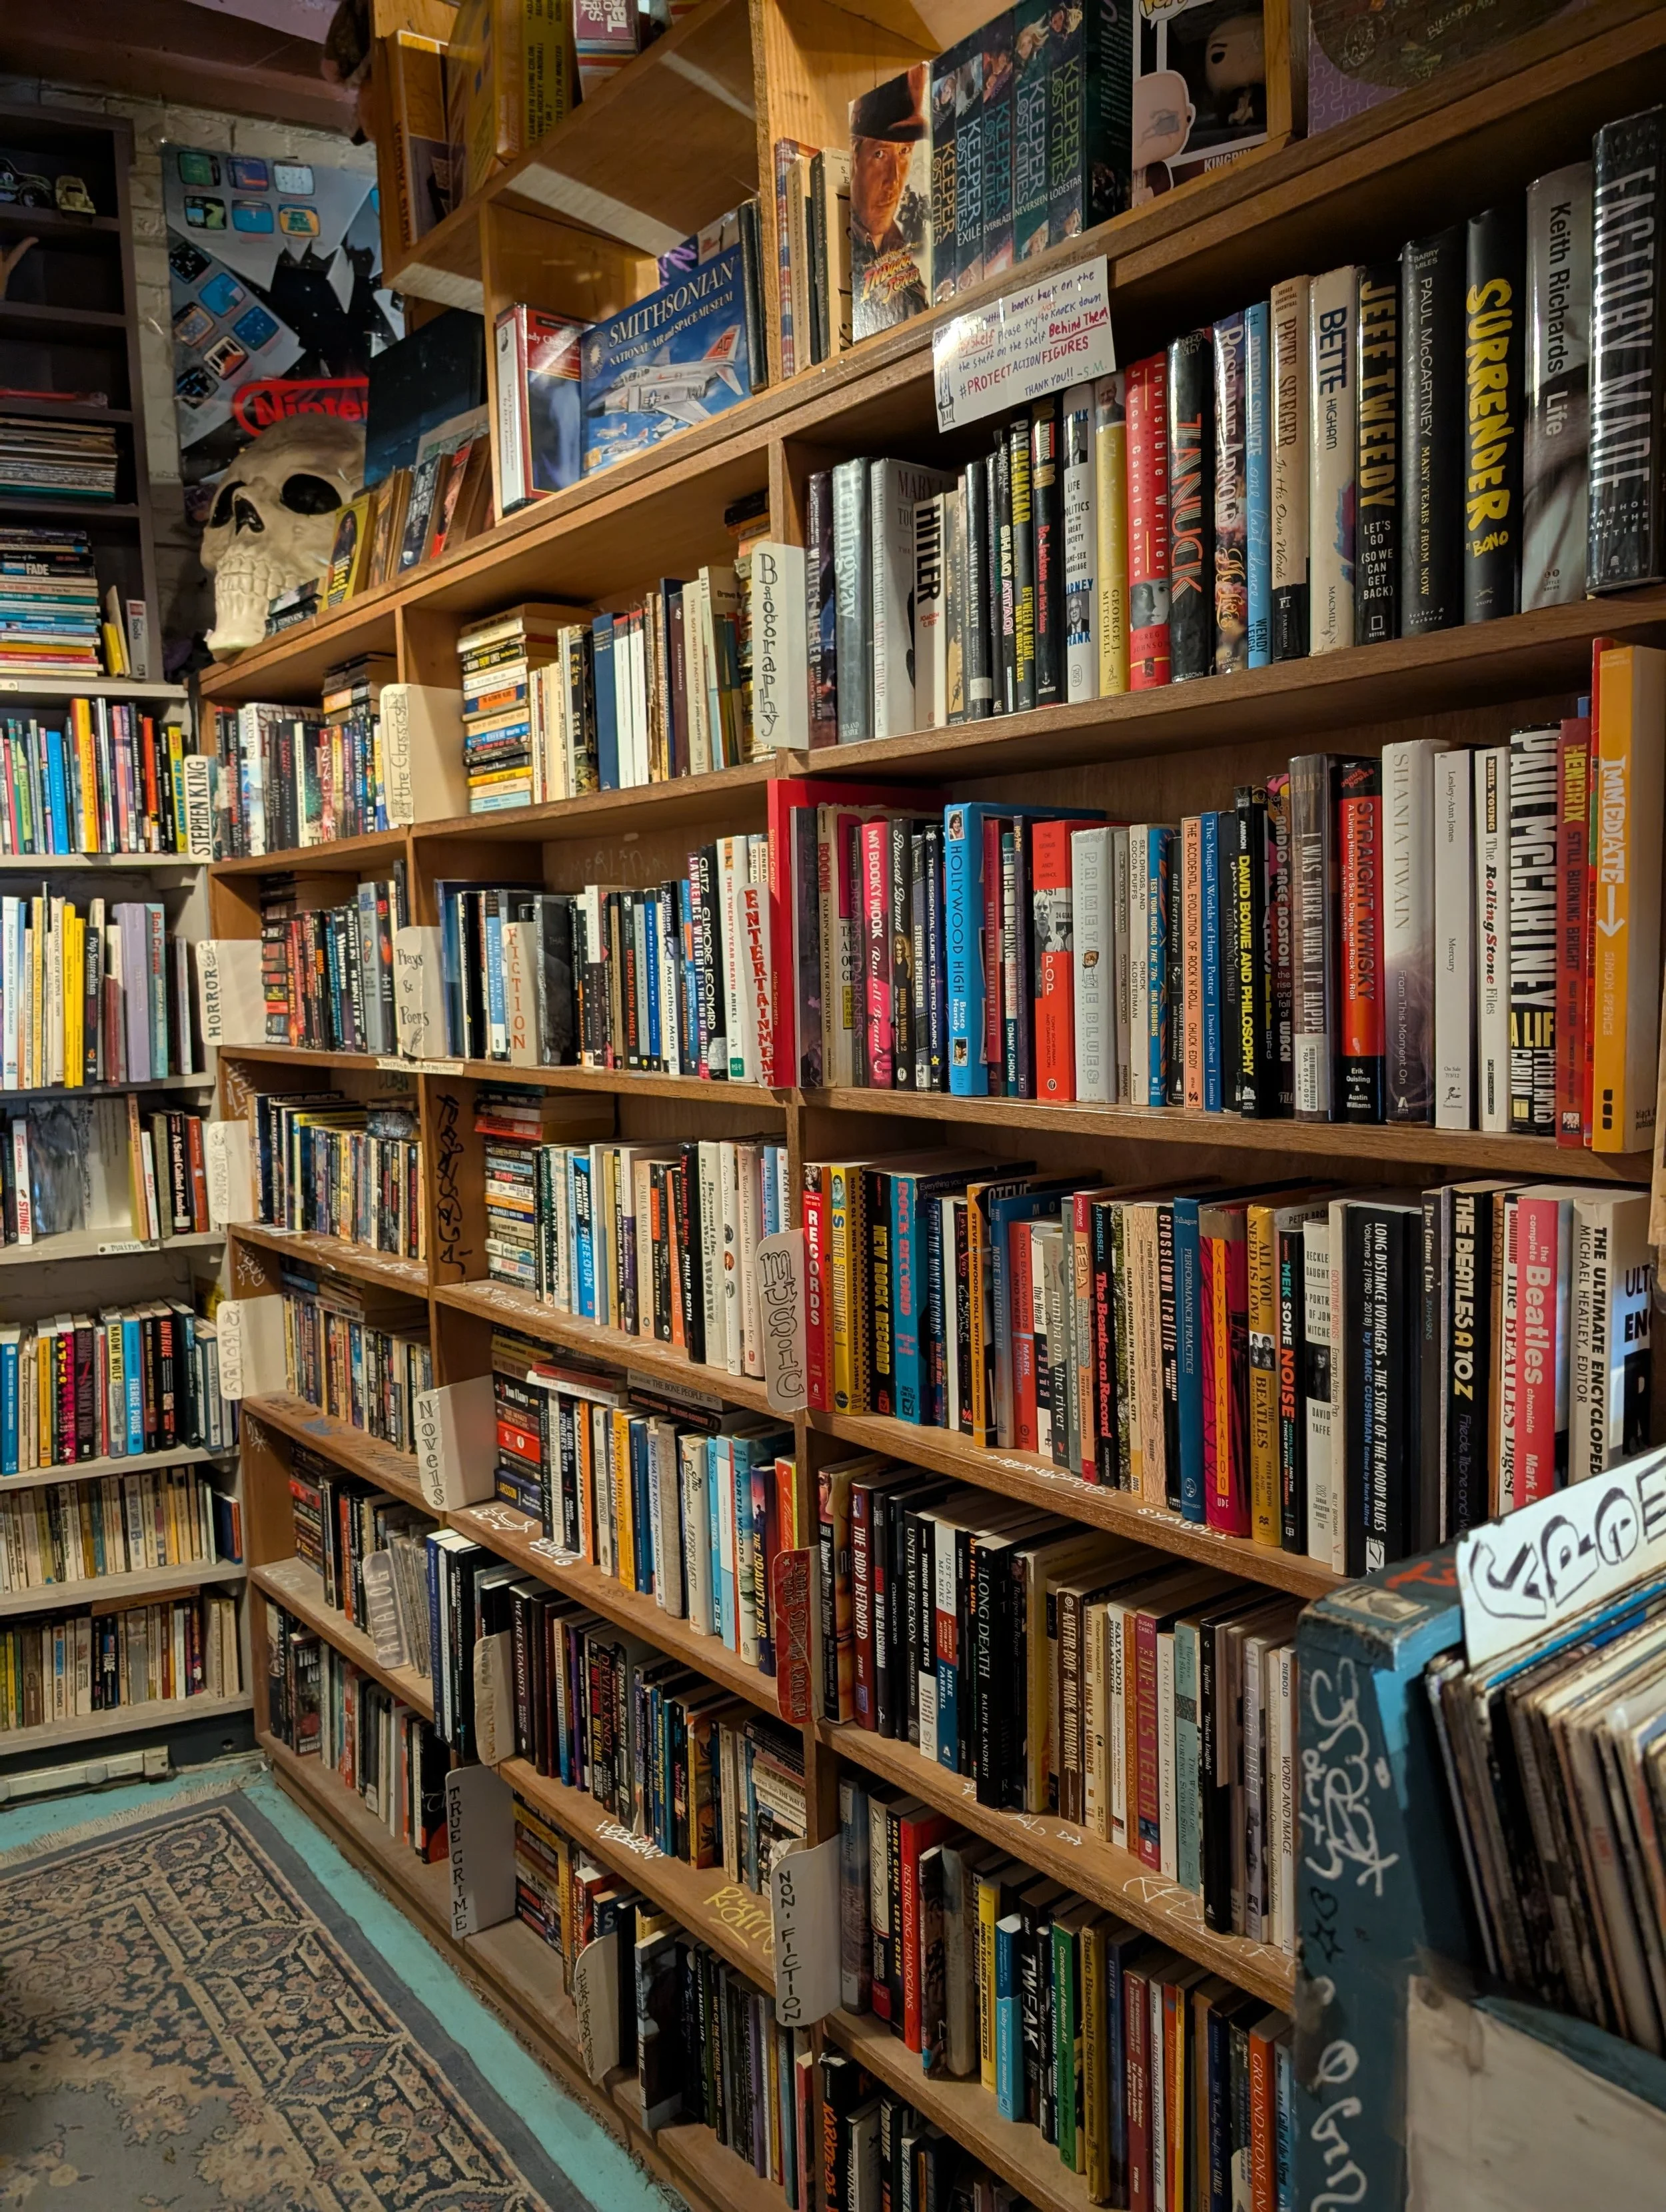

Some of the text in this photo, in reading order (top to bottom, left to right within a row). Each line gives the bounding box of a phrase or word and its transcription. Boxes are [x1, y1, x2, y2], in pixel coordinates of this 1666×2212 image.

[1052, 67, 1064, 187] LOST CITIES
[1066, 60, 1080, 168] KEEPER
[1049, 175, 1082, 200] LODESTAR
[610, 257, 735, 347] SMITHSONIAN
[610, 342, 650, 365] NATIONAL
[652, 333, 665, 348] AIR
[675, 312, 698, 333] SPACE
[700, 292, 733, 318] MUSEUM
[1012, 271, 1095, 312] books back on the
[1549, 202, 1573, 373] Keith Richards
[1589, 168, 1657, 496] FACTORY MADE
[973, 350, 993, 368] stuff
[1025, 332, 1046, 350] shelf
[1048, 318, 1080, 338] Behind
[1025, 379, 1049, 396] THANK
[1051, 368, 1074, 385] YOU!!
[1319, 306, 1347, 397] BETTE
[1419, 277, 1433, 437] PAUL McCARTNEY
[1360, 281, 1395, 507] JEFF TWEEDY
[1466, 278, 1514, 531] SURRENDER
[1544, 390, 1568, 436] Life
[1011, 420, 1030, 524] PAT BENATAR
[1172, 413, 1202, 603] ZANUCK
[836, 466, 864, 618] Hemingway
[916, 503, 942, 604] HITLER
[1361, 548, 1393, 564] (SO WE
[1363, 520, 1391, 534] LET'S
[1367, 562, 1387, 575] CAN
[1369, 532, 1384, 545] GO
[1473, 530, 1509, 558] BONO
[1363, 586, 1393, 600] BACK)
[1367, 574, 1387, 586] GET
[191, 760, 210, 855] STEPHEN KING
[393, 773, 411, 797] the
[1393, 754, 1409, 930] SHANIA TWAIN
[396, 949, 424, 969] Plays
[950, 845, 964, 993] HOLLYWOOD HIGH
[204, 967, 221, 1039] HORROR
[506, 927, 526, 1049] FICTION
[704, 970, 716, 1030] LEONARD
[1238, 855, 1254, 1075] DAVID BOWIE AND PHILOSOPHY
[400, 1005, 429, 1026] Poems
[19, 1199, 30, 1236] STUNG!
[808, 1209, 820, 1326] RECORDS
[873, 1225, 890, 1375] NEW ROCK RECORD
[1454, 1197, 1474, 1401] THE BEATLES A TO Z
[161, 1320, 173, 1359] UNTRUE
[1523, 1265, 1551, 1384] Beatles
[129, 1378, 141, 1407] FIERCE
[652, 1379, 664, 1390] THE
[681, 1386, 703, 1401] PEOPLE
[650, 1458, 658, 1491] WATER
[1139, 1658, 1158, 1817] DEVIL'S TEETH
[449, 1786, 467, 1932] TRUE CRIME
[1020, 1953, 1040, 2051] TWEAK
